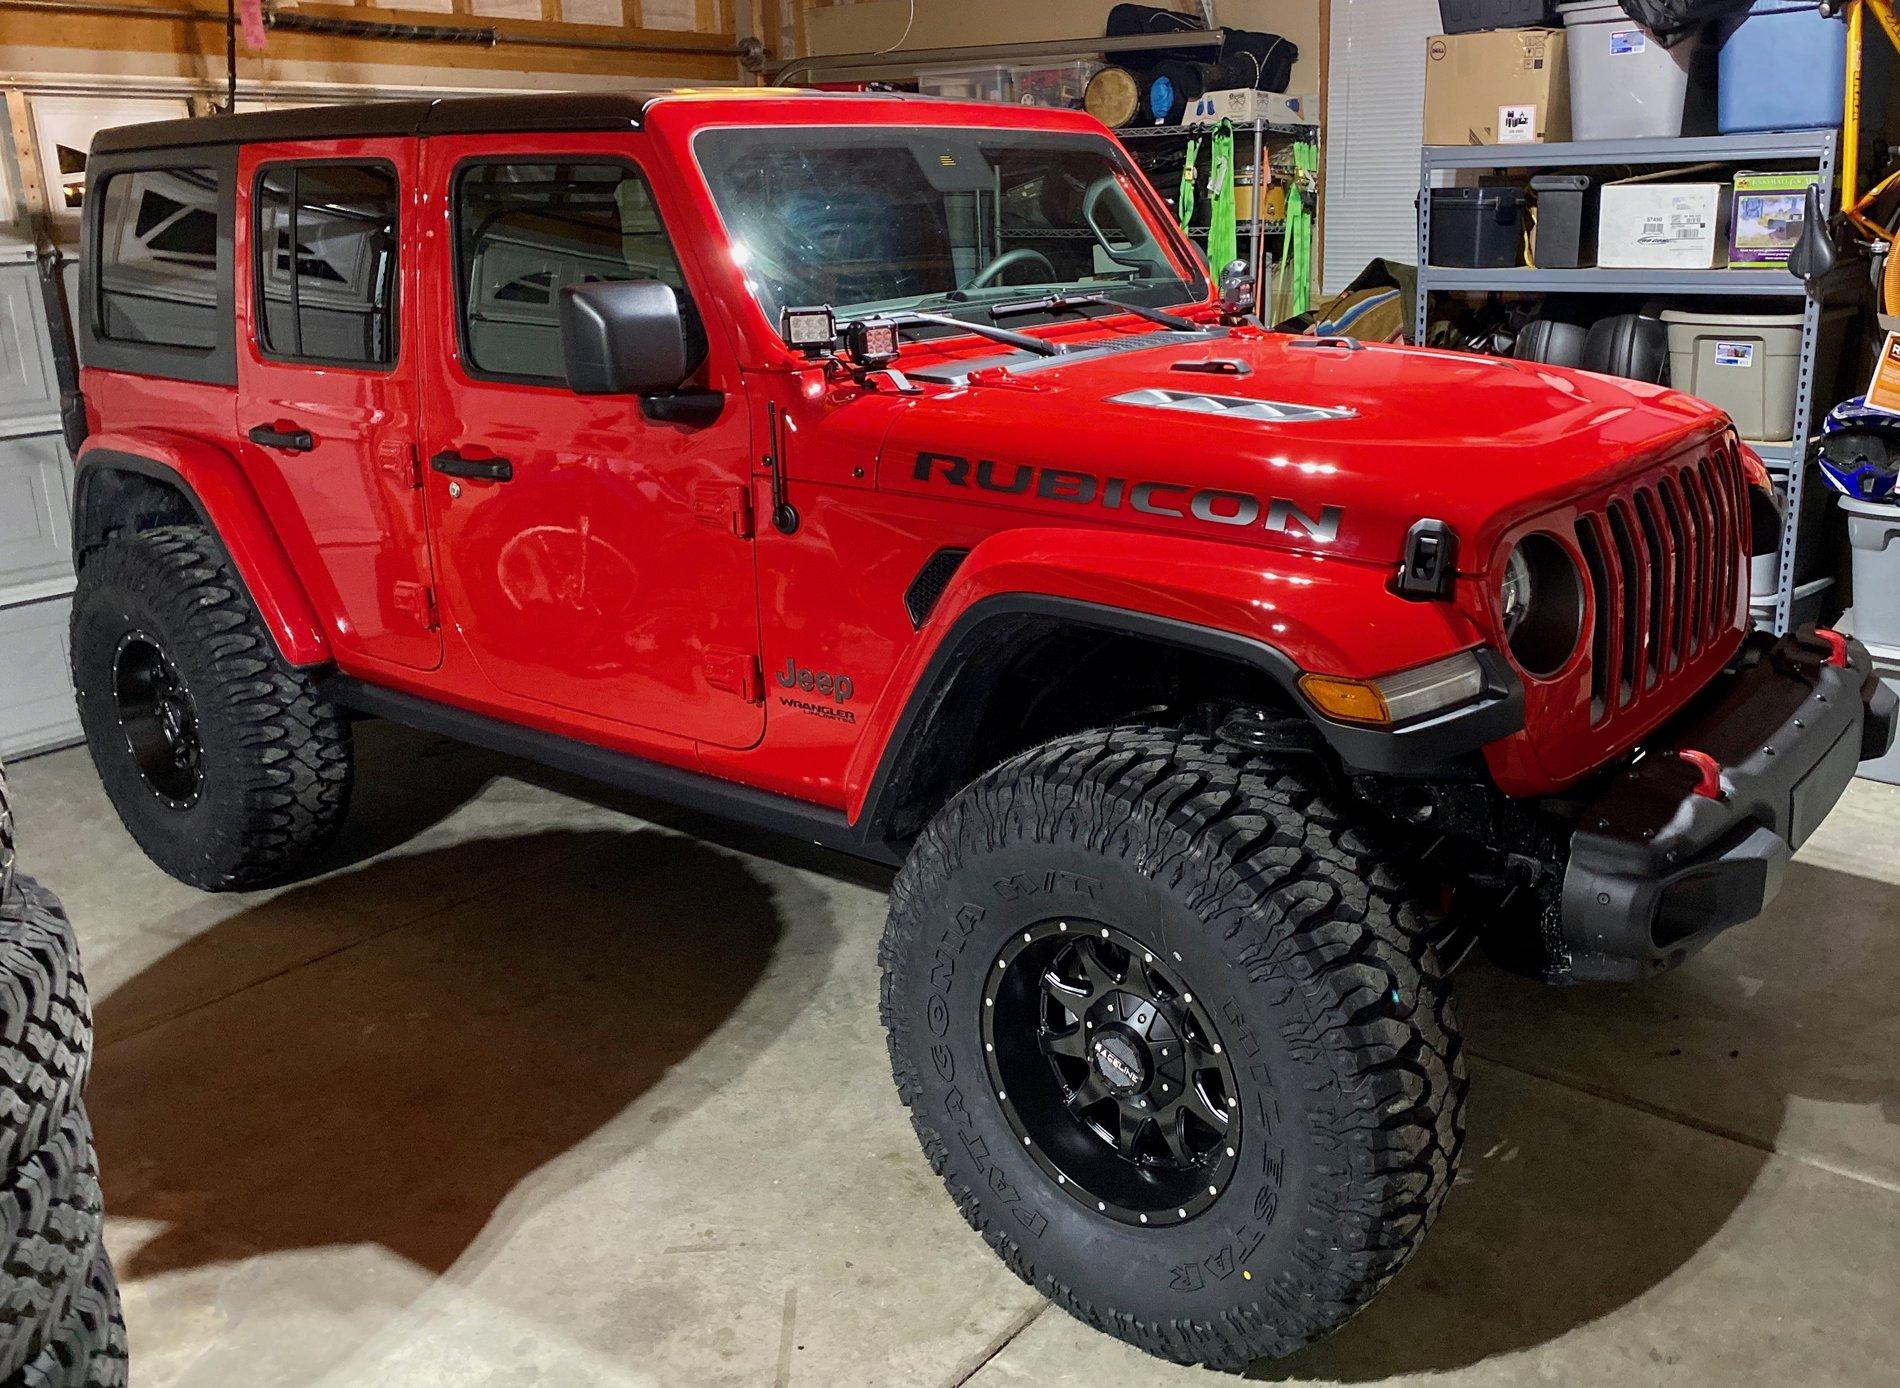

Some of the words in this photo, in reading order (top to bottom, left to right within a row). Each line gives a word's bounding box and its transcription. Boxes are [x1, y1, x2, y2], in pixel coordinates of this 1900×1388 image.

[912, 450, 1347, 542] RUBICON
[776, 656, 854, 704] Jeep
[779, 696, 855, 720] WRANGLER
[803, 709, 856, 725] UNLIMITED
[926, 903, 1049, 1239] PATAGONIA
[992, 869, 1105, 901] M/T
[1169, 995, 1286, 1293] MILESTAR
